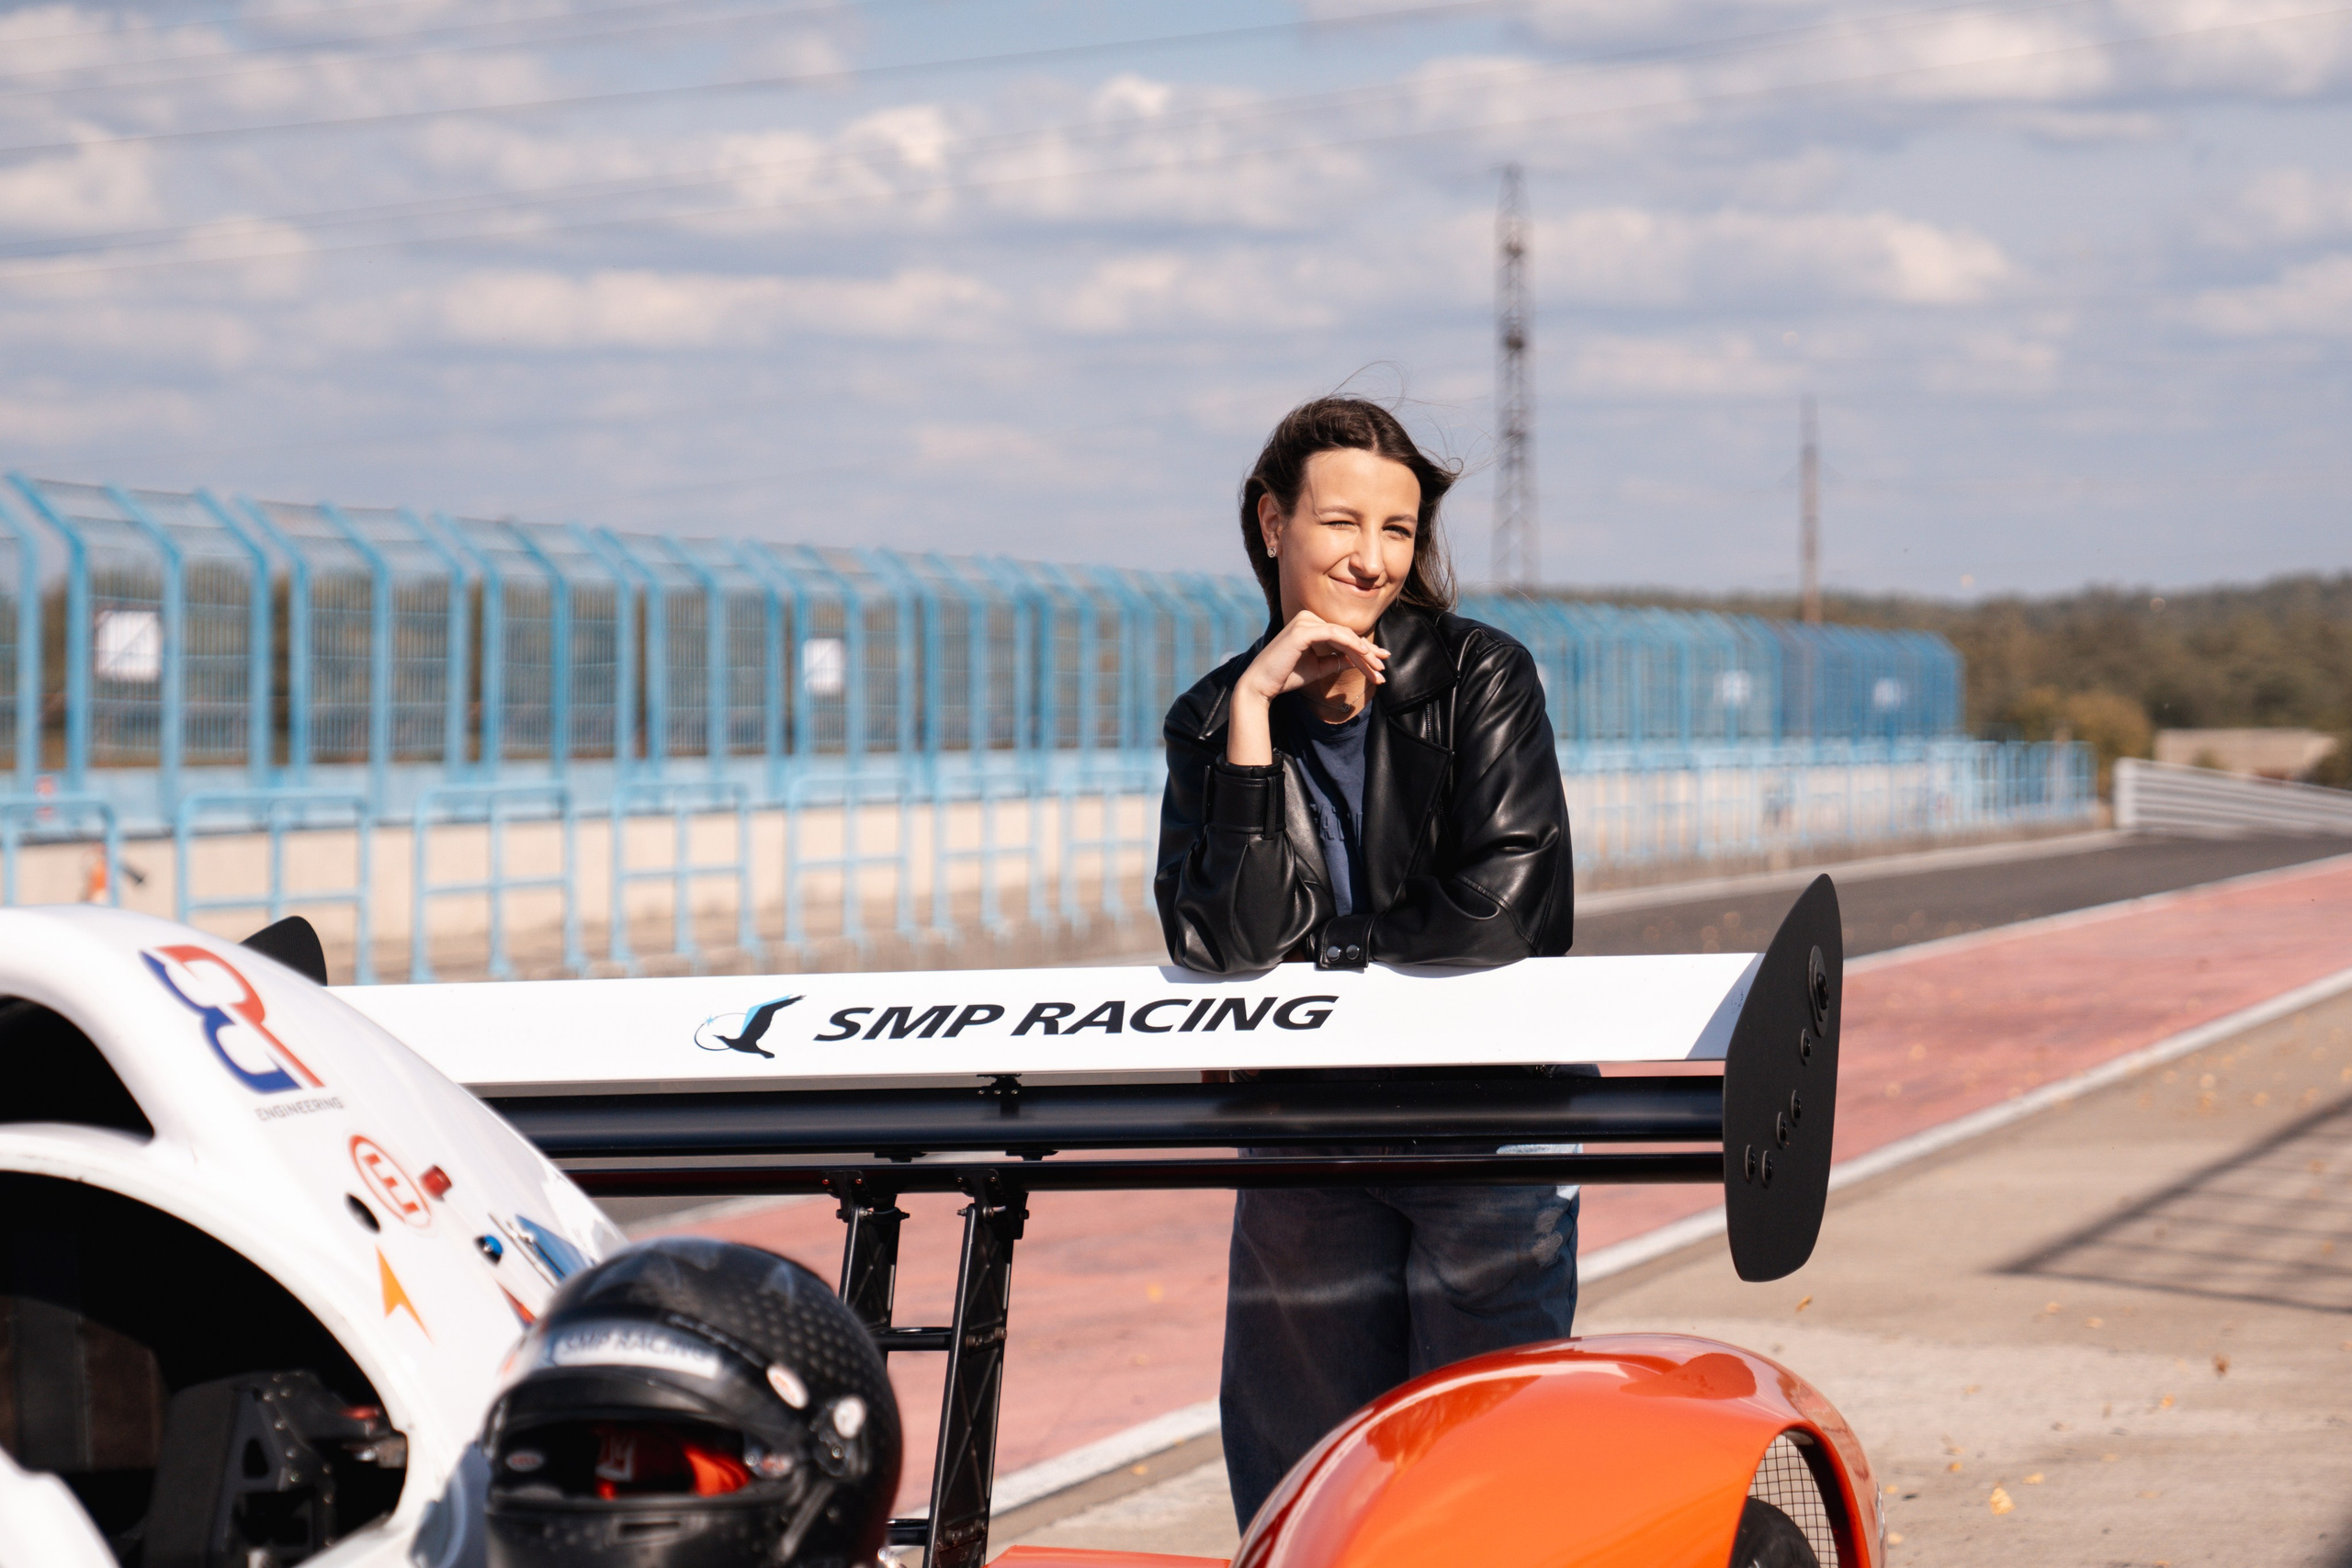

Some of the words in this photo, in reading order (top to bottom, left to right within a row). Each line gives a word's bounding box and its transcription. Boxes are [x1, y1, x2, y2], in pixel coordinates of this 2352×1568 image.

[813, 1003, 1005, 1042] SMP
[1011, 995, 1340, 1036] RACING
[254, 1097, 345, 1122] ENGINEERING
